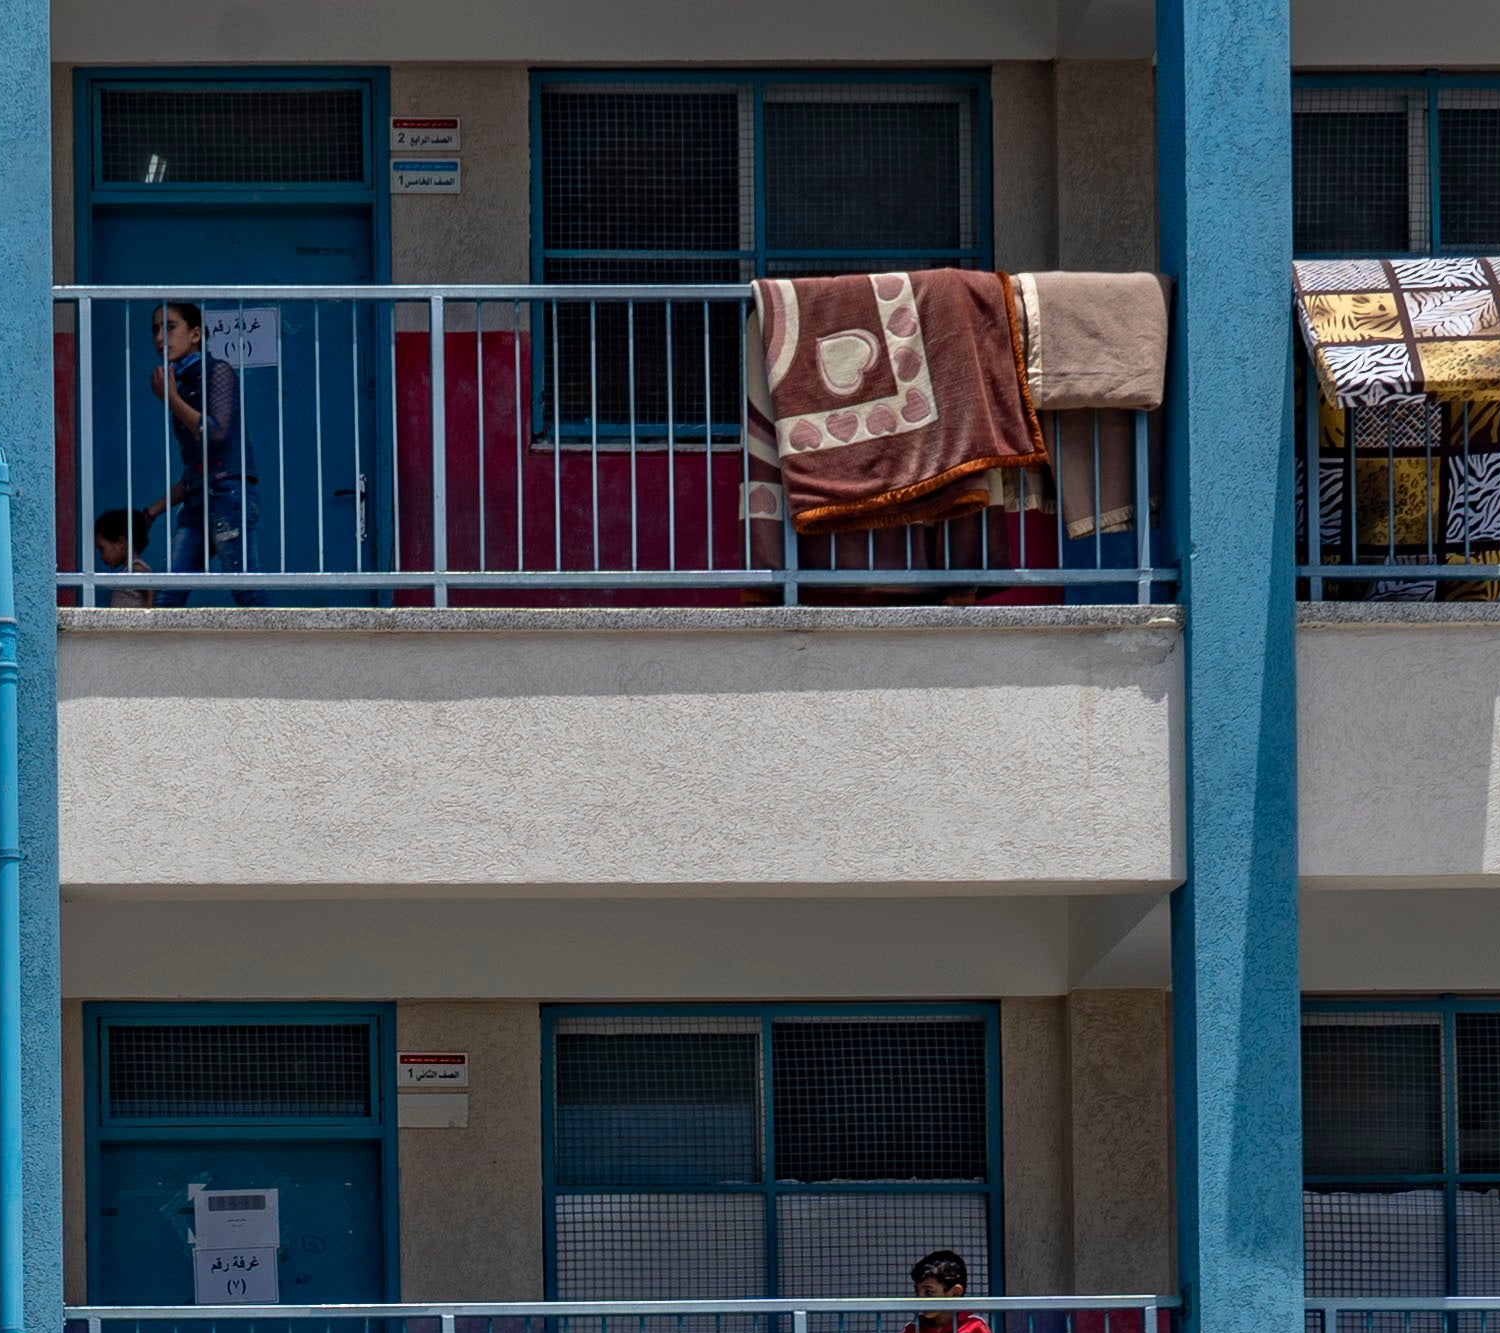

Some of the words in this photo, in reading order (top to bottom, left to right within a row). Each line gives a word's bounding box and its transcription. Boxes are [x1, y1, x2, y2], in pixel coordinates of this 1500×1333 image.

[398, 134, 405, 143] 2
[431, 134, 452, 145] الصف
[398, 175, 404, 185] 1
[433, 175, 455, 187] الصف
[407, 1069, 413, 1079] 1
[437, 1069, 459, 1081] الصف
[211, 1257, 230, 1274] رقم
[232, 1256, 260, 1271] غرفة
